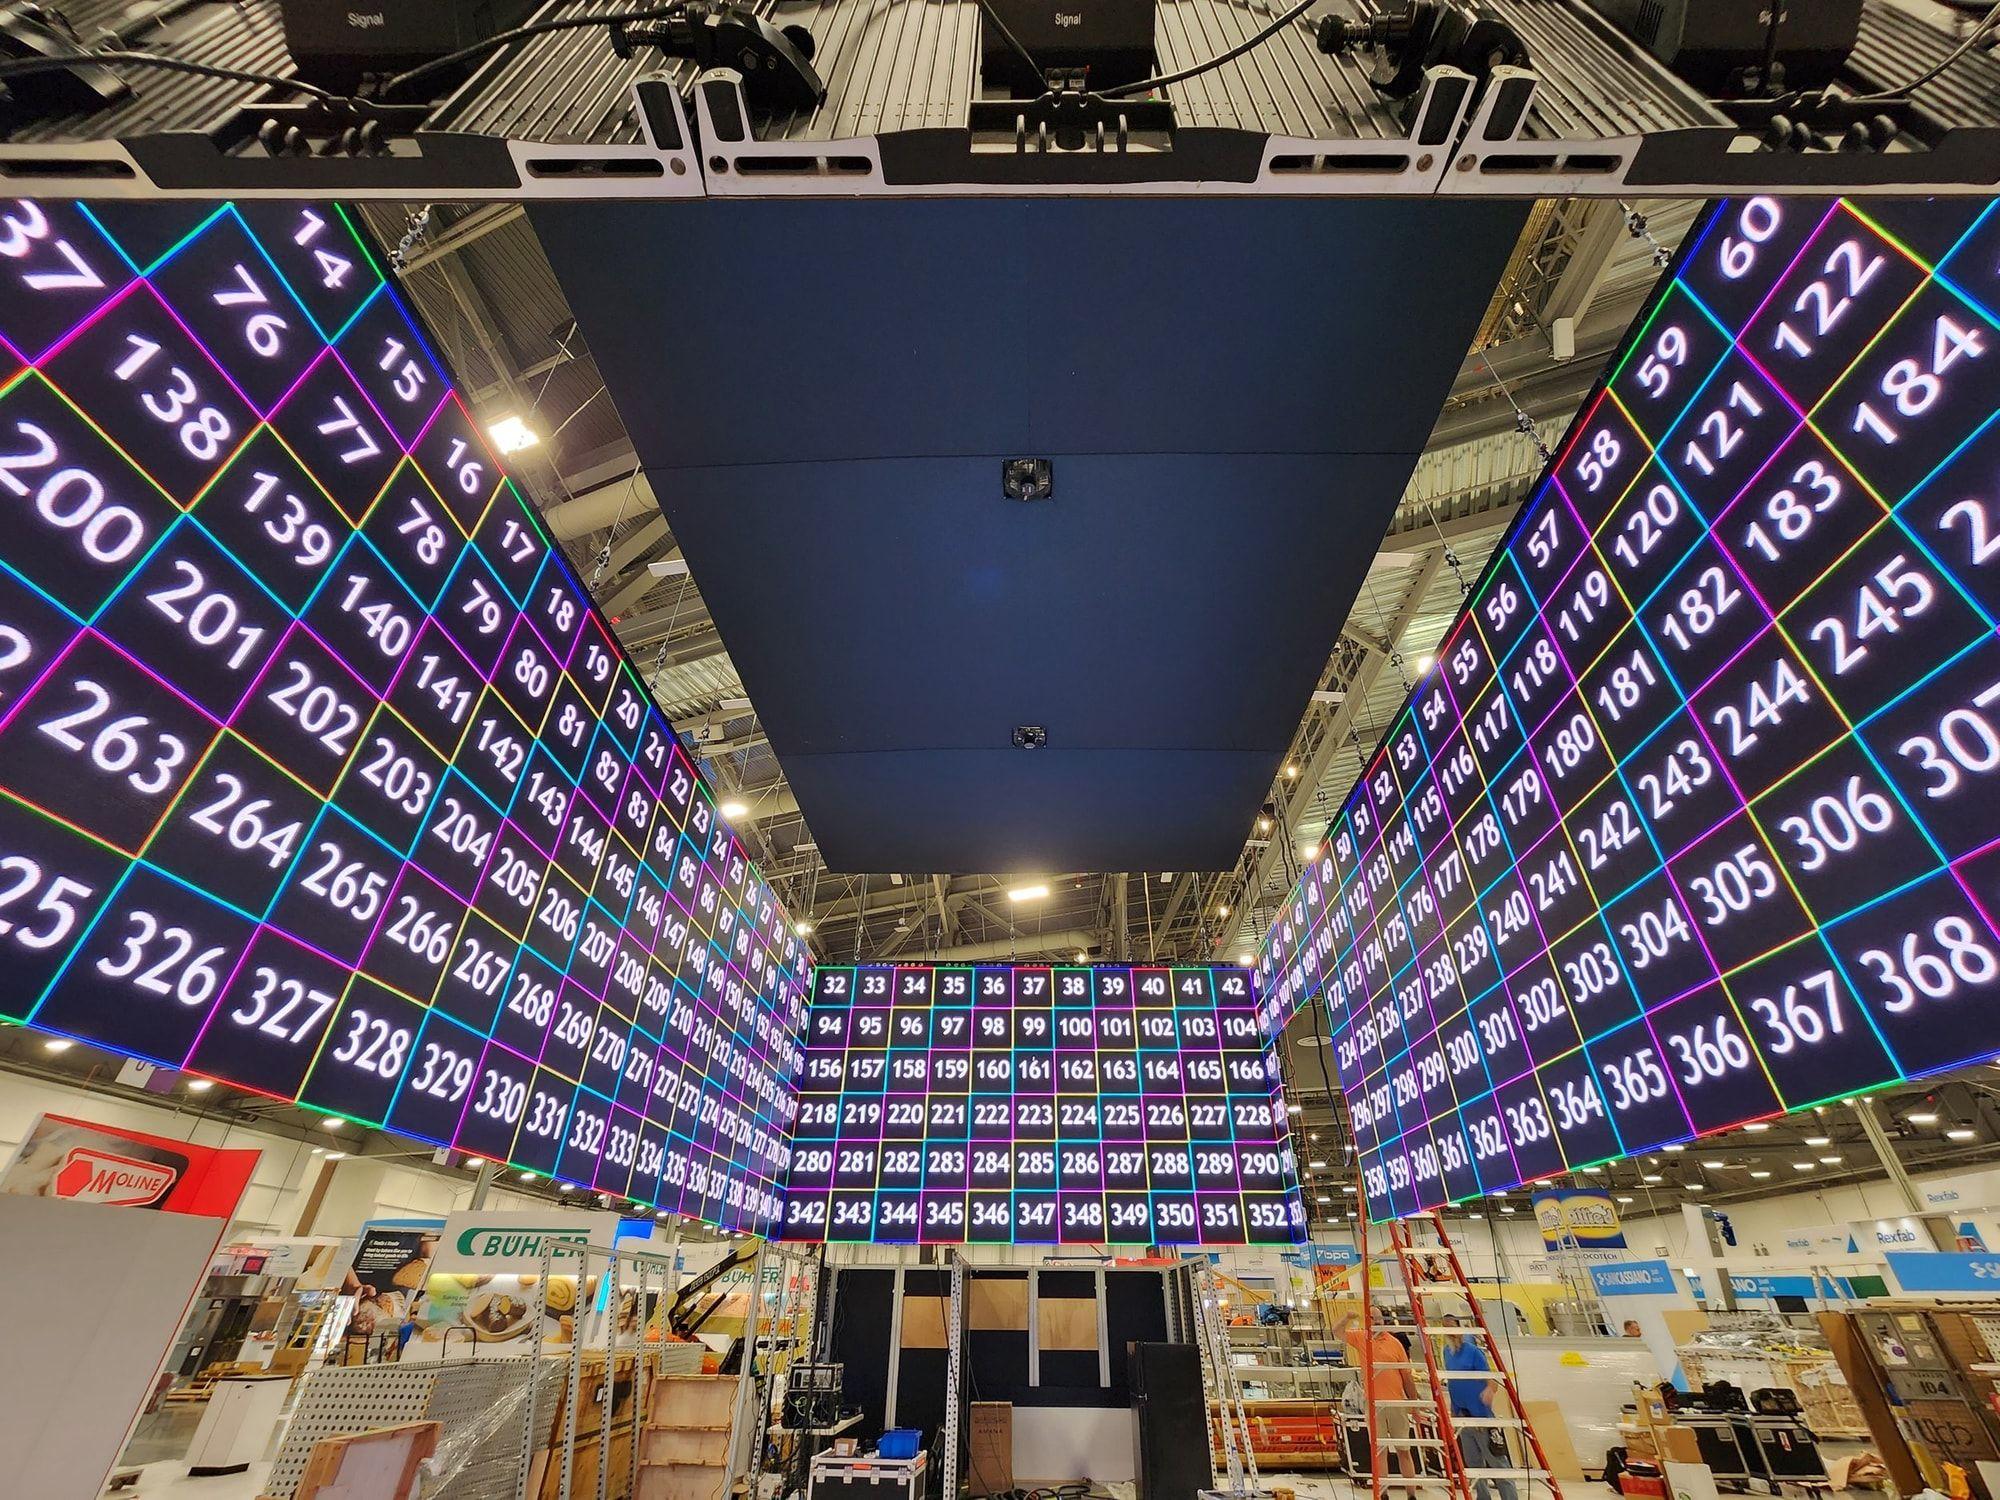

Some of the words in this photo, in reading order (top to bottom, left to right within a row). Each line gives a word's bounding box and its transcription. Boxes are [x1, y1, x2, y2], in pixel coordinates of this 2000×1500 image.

[348, 12, 384, 29] Signal
[1055, 12, 1082, 28] Signal
[115, 335, 230, 459] 138
[245, 472, 330, 565] 139
[342, 575, 409, 656] 140
[417, 656, 471, 723] 141
[478, 720, 523, 782] 142
[528, 773, 565, 825] 143
[213, 265, 286, 356] 76
[318, 396, 379, 463] 77
[398, 498, 443, 564] 78
[463, 579, 499, 633] 79
[515, 650, 547, 697] 80
[559, 705, 585, 747] 81
[596, 751, 619, 793] 82
[628, 791, 648, 828] 83
[295, 210, 351, 287] 14
[380, 338, 425, 401] 15
[447, 439, 482, 493] 16
[502, 521, 535, 562] 17
[548, 588, 573, 631] 18
[587, 646, 608, 681] 19
[616, 690, 638, 729] 20
[645, 732, 664, 768] 21
[670, 769, 688, 804] 22
[693, 802, 708, 833] 23
[1354, 804, 1369, 835] 51
[1375, 771, 1393, 804] 52
[1397, 734, 1416, 770] 53
[1423, 690, 1445, 730] 54
[1453, 639, 1477, 684] 55
[1487, 583, 1516, 631] 56
[1528, 509, 1558, 567] 57
[1577, 430, 1620, 491] 58
[1637, 327, 1686, 398] 59
[1721, 197, 1780, 278] 60
[1443, 746, 1473, 795] 116
[1475, 694, 1507, 752] 117
[1514, 640, 1556, 701] 118
[1560, 571, 1607, 640] 119
[1615, 485, 1678, 567] 120
[1686, 382, 1762, 474] 121
[1775, 241, 1884, 357] 122
[1466, 814, 1500, 864] 178
[1503, 769, 1540, 825] 179
[1546, 715, 1594, 777] 180
[1599, 650, 1655, 720] 181
[1664, 567, 1741, 650] 182
[1746, 461, 1840, 560] 183
[1854, 316, 1983, 443] 184
[0, 423, 143, 562] 200
[146, 561, 263, 669] 201
[268, 662, 357, 755] 202
[360, 738, 430, 814] 203
[432, 799, 491, 866] 204
[491, 848, 540, 906] 205
[1489, 891, 1529, 945] 240
[1530, 851, 1577, 911] 241
[1579, 802, 1640, 869] 242
[1639, 740, 1711, 819] 243
[1714, 659, 1809, 755] 244
[1811, 555, 1933, 674] 245
[38, 681, 185, 793] 263
[190, 774, 301, 868] 264
[301, 843, 387, 920] 265
[386, 896, 452, 963] 266
[453, 939, 511, 995] 267
[508, 974, 554, 1026] 268
[824, 976, 845, 993] 32
[863, 977, 885, 994] 33
[903, 977, 926, 994] 34
[943, 977, 964, 994] 35
[983, 977, 1005, 994] 36
[1023, 977, 1045, 994] 37
[1063, 977, 1084, 995] 38
[1103, 978, 1124, 995] 39
[1142, 978, 1164, 995] 40
[1182, 978, 1202, 994] 41
[1222, 978, 1245, 994] 42
[1479, 1007, 1516, 1054] 301
[1518, 978, 1566, 1031] 302
[1565, 943, 1619, 1002] 303
[1621, 898, 1690, 968] 304
[1691, 844, 1776, 924] 305
[1780, 776, 1892, 870] 306
[97, 911, 224, 1005] 326
[232, 968, 335, 1043] 327
[333, 1010, 409, 1077] 328
[412, 1043, 472, 1101] 329
[475, 1070, 525, 1123] 330
[526, 1092, 567, 1139] 331
[569, 1111, 604, 1154] 332
[809, 1059, 841, 1077] 156
[851, 1059, 885, 1078] 157
[893, 1059, 925, 1078] 158
[935, 1060, 968, 1078] 159
[977, 1060, 1010, 1079] 160
[1019, 1057, 1049, 1079] 161
[1061, 1060, 1094, 1079] 162
[1103, 1060, 1136, 1079] 163
[1144, 1059, 1179, 1079] 164
[1188, 1061, 1221, 1079] 165
[1230, 1061, 1264, 1079] 166
[819, 1017, 841, 1034] 94
[860, 1017, 881, 1034] 95
[901, 1017, 922, 1035] 96
[941, 1017, 964, 1035] 97
[982, 1017, 1004, 1035] 98
[1023, 1017, 1045, 1035] 99
[1060, 1018, 1092, 1036] 100
[1101, 1018, 1130, 1036] 101
[1438, 1132, 1468, 1171] 361
[1469, 1116, 1507, 1159] 362
[1506, 1098, 1549, 1146] 363
[1550, 1075, 1603, 1129] 364
[1604, 1049, 1666, 1109] 365
[1669, 1016, 1748, 1084] 366
[1752, 970, 1843, 1053] 367
[1860, 917, 1997, 1012] 368
[788, 1201, 825, 1223] 342
[834, 1201, 870, 1224] 343
[880, 1202, 917, 1224] 344
[926, 1202, 963, 1224] 345
[973, 1202, 1009, 1225] 346
[1019, 1197, 1059, 1225] 347
[1065, 1203, 1102, 1225] 348
[1111, 1203, 1147, 1225] 349
[1157, 1204, 1194, 1226] 350
[1203, 1204, 1238, 1226] 351
[1249, 1204, 1288, 1226] 352
[1876, 1229, 1916, 1244] Rexfab
[1927, 1190, 1959, 1203] Rexfab
